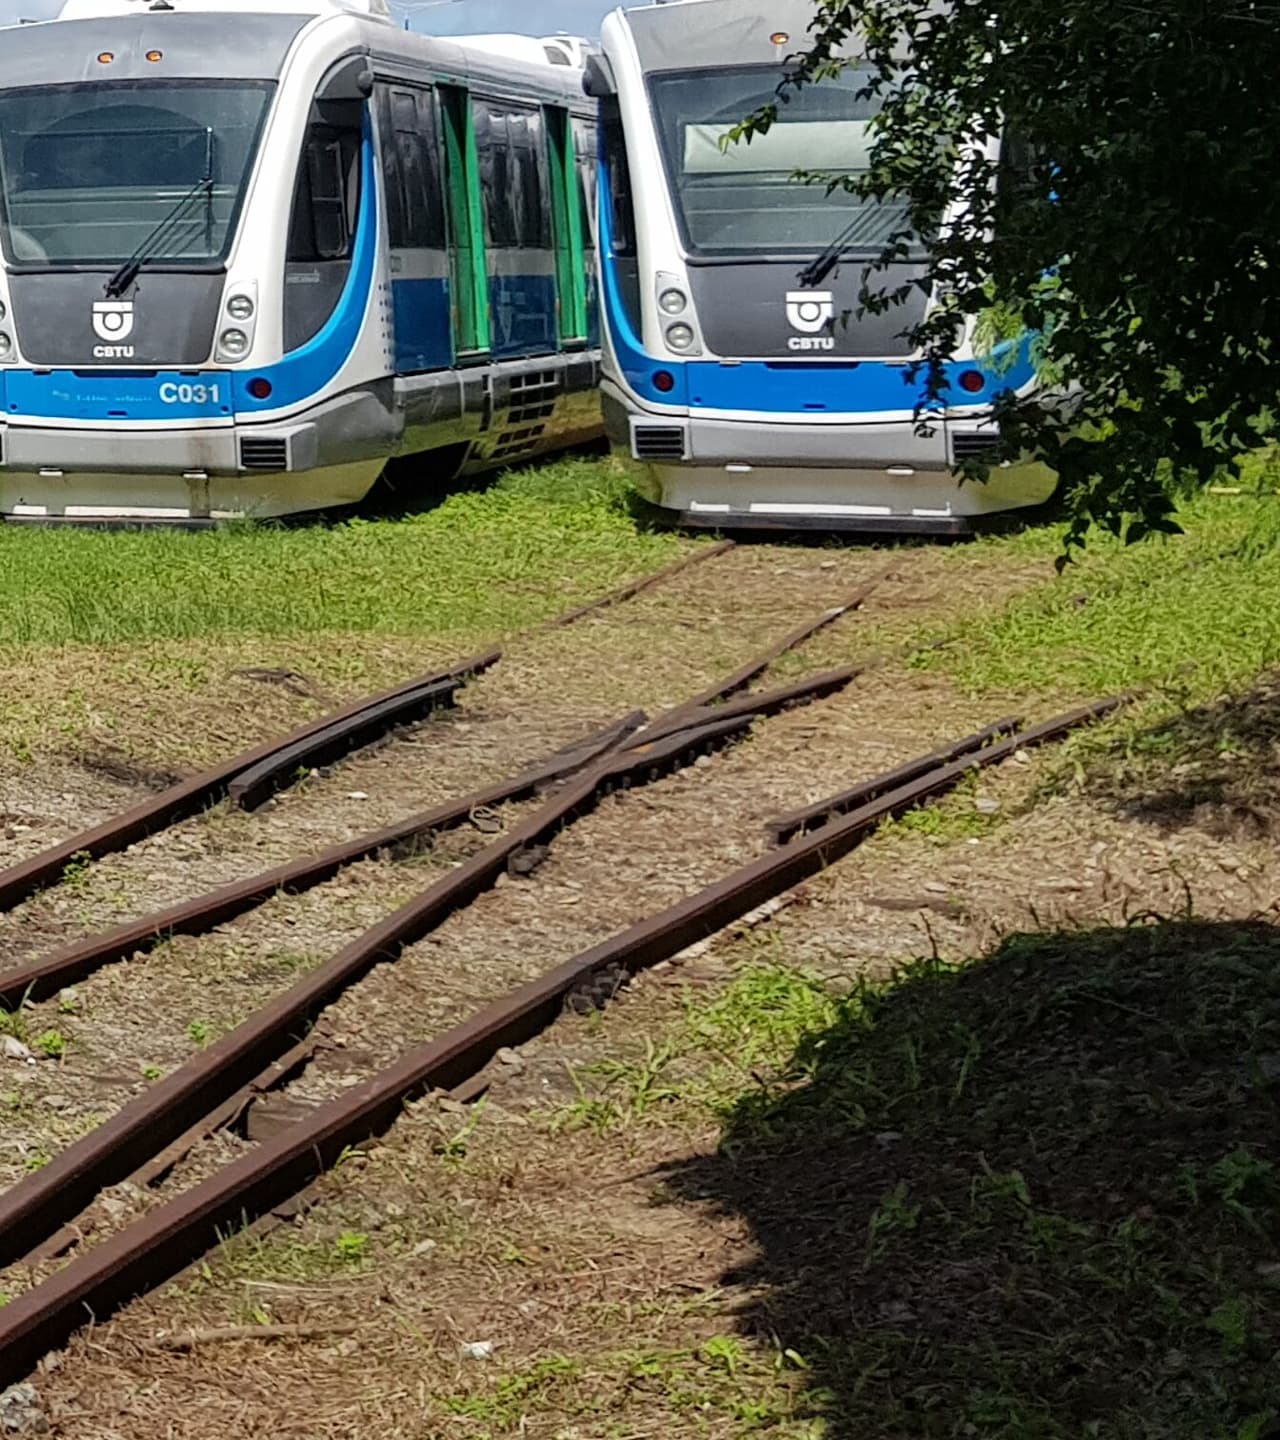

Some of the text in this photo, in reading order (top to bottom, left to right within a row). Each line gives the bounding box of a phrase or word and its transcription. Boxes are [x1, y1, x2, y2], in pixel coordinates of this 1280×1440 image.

[787, 336, 835, 351] CBTU
[92, 345, 135, 358] CBTU
[158, 382, 221, 404] C031
